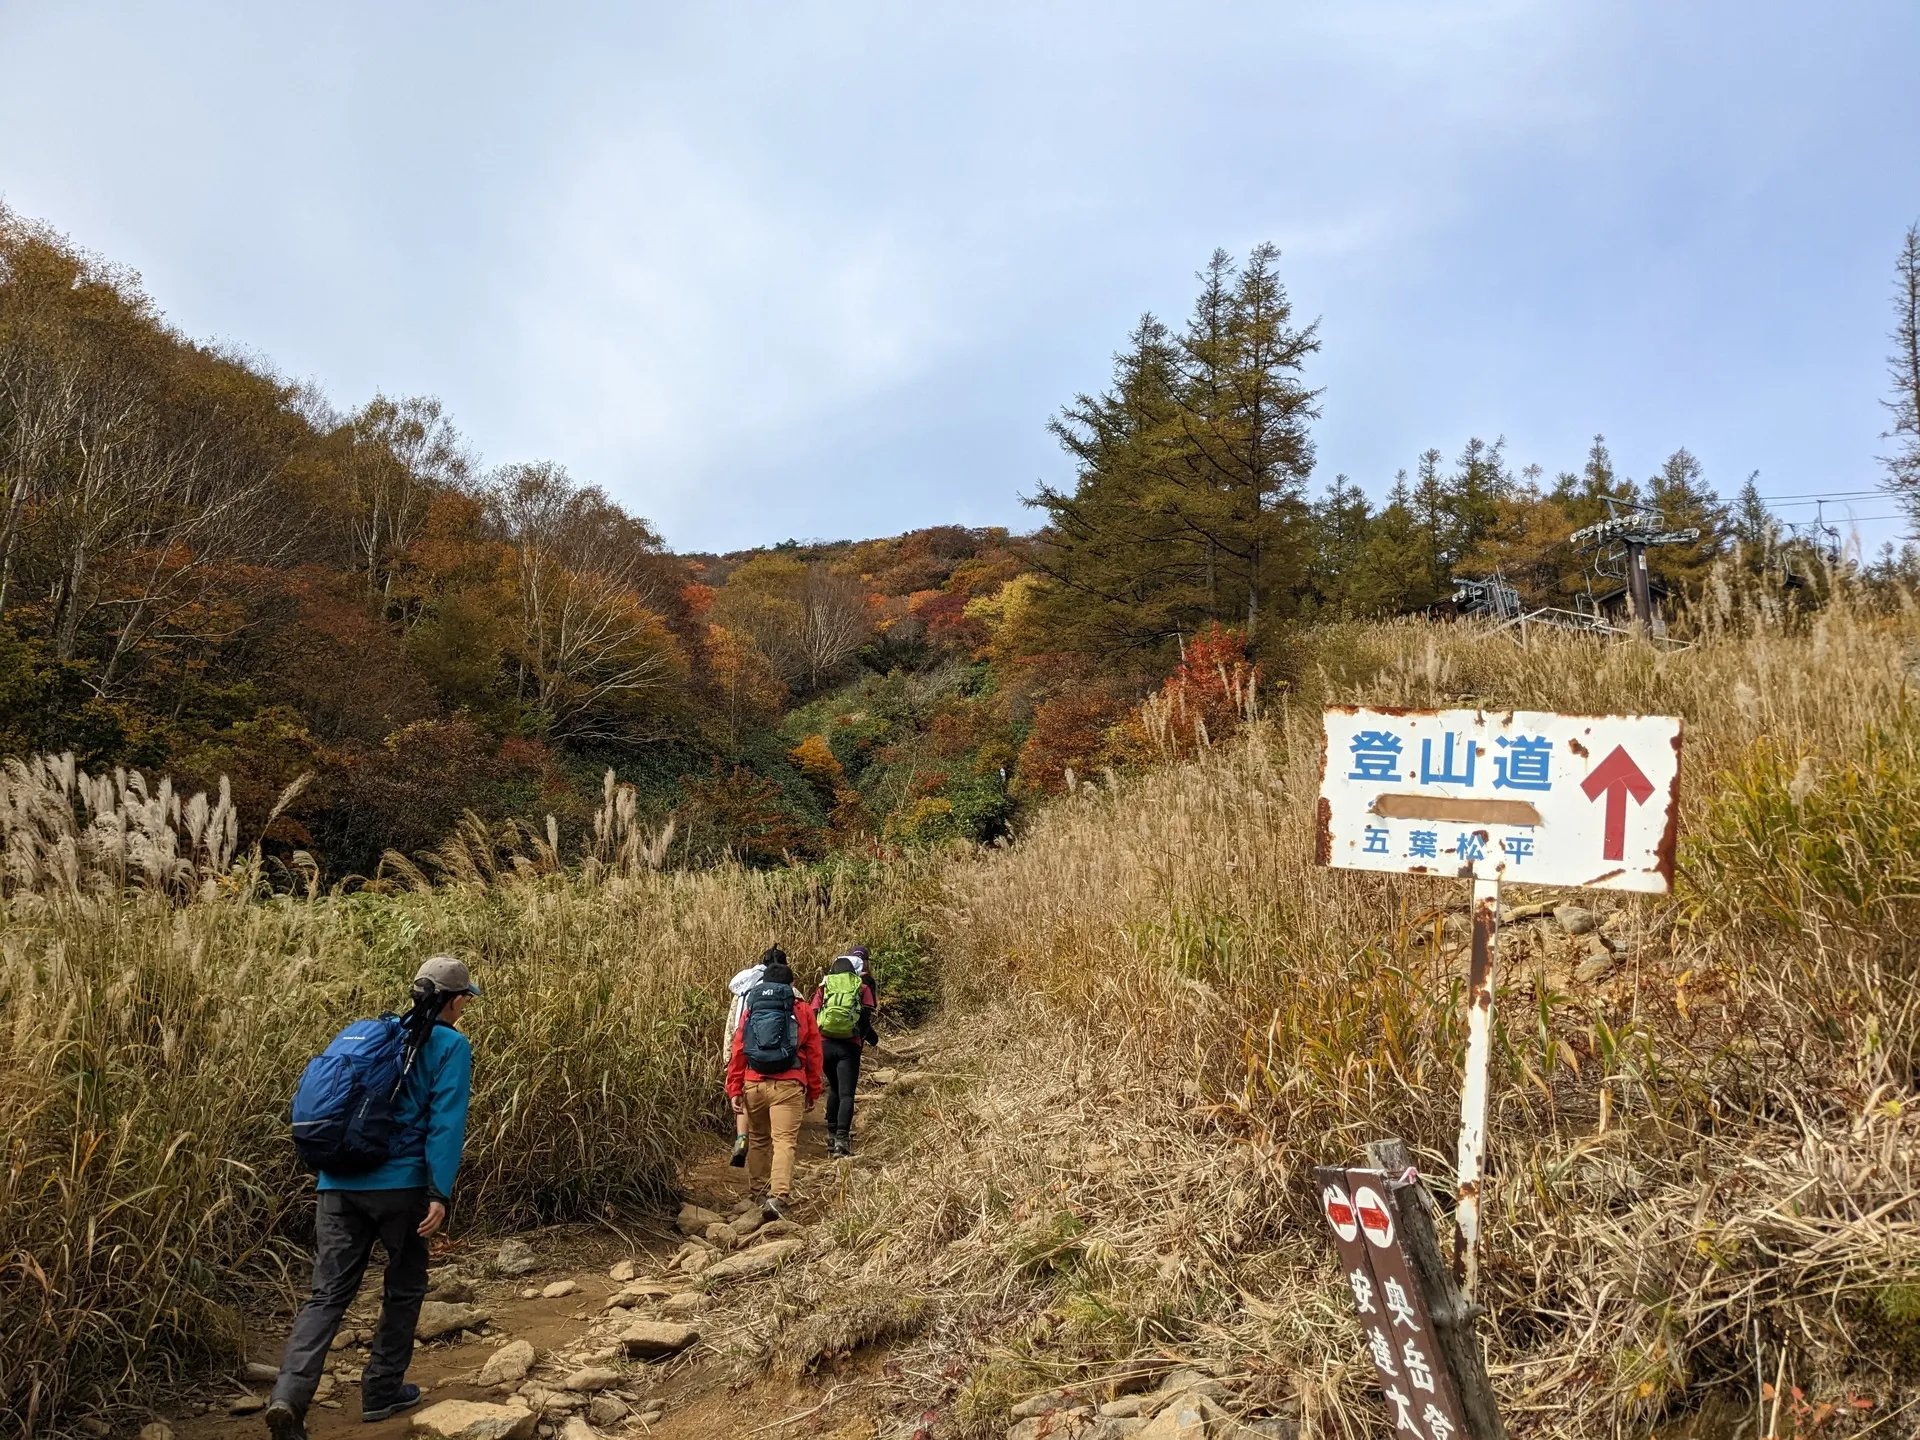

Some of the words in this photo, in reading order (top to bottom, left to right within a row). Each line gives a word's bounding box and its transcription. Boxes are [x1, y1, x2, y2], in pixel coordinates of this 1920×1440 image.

[1348, 730, 1553, 791] 登山道
[1362, 828, 1534, 865] 五葉松平
